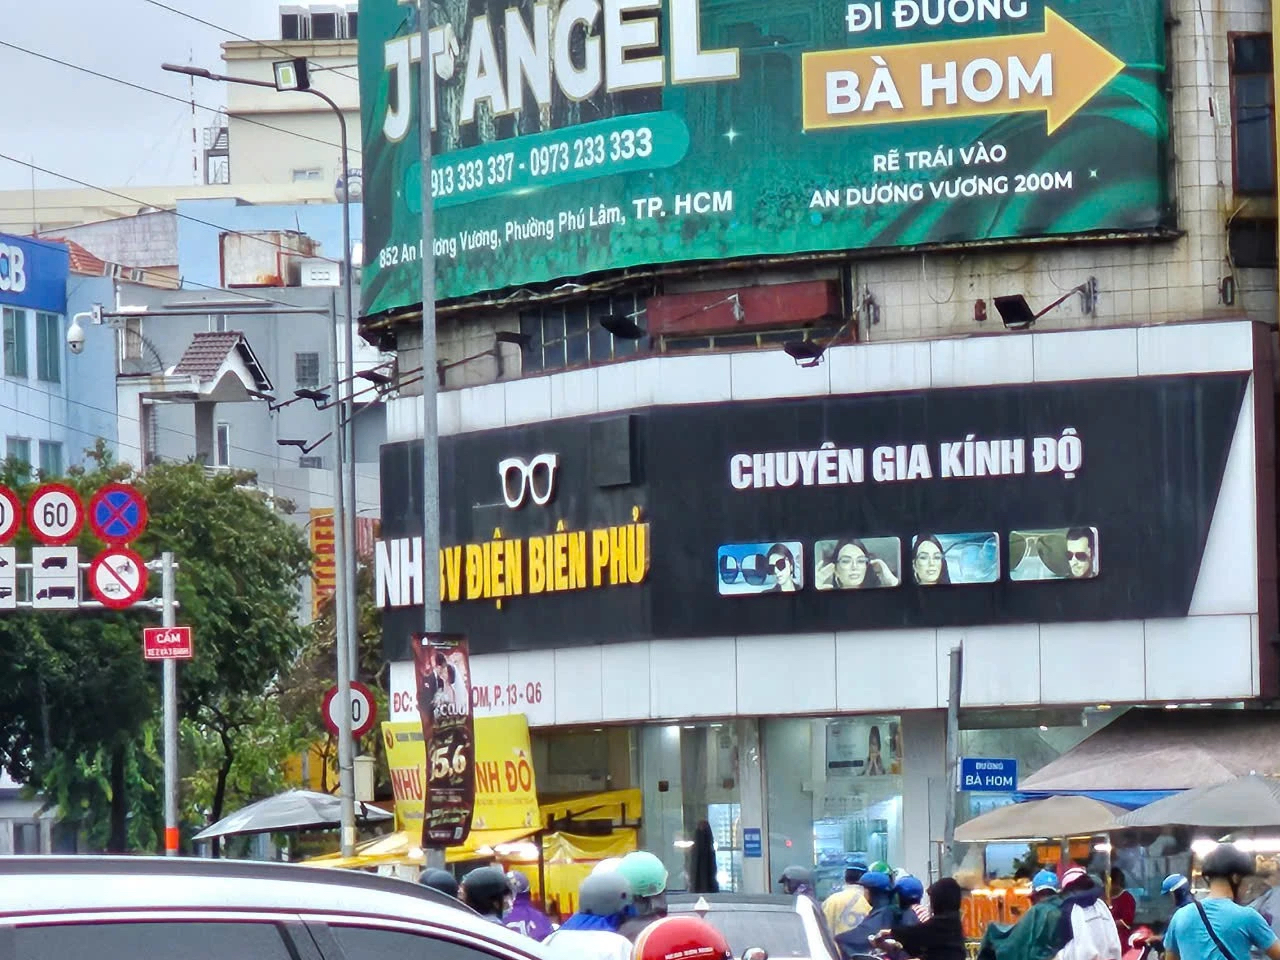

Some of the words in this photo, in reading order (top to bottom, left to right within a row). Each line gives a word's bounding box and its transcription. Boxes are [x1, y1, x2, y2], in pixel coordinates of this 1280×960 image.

[845, 4, 883, 32] ĐI
[825, 56, 903, 115] BÀ
[921, 52, 1054, 107] HOM
[430, 167, 454, 198] 913
[457, 161, 483, 192] 333
[487, 156, 514, 187] 337
[530, 145, 569, 177] 0973
[573, 138, 605, 169] 233
[609, 127, 653, 161] 333
[873, 148, 900, 172] RẼ
[905, 141, 954, 169] TRÁI
[959, 141, 1007, 165] VÀO
[809, 190, 840, 208] AN
[846, 182, 923, 206] DƯƠNG
[929, 175, 1009, 199] VƯƠNG
[1014, 171, 1073, 193] 200M
[379, 244, 399, 268] 852
[401, 243, 417, 262] An
[558, 207, 586, 233] Phú
[632, 198, 666, 219] TP.
[674, 190, 733, 216] HCM
[729, 441, 864, 489] CHUYÊN
[871, 443, 932, 482] GIA
[940, 433, 1026, 478] KÍNH
[1031, 427, 1082, 480] ĐỘ
[43, 502, 69, 527] 60
[465, 527, 523, 609] ĐIỆN
[529, 519, 586, 594] BIÊN
[592, 505, 647, 586] PHỦ
[352, 698, 361, 723] 0
[393, 691, 413, 713] ĐC:
[471, 686, 491, 711] OM,
[525, 681, 542, 705] Q6
[965, 772, 983, 786] BÀ
[985, 775, 1013, 786] HOM
